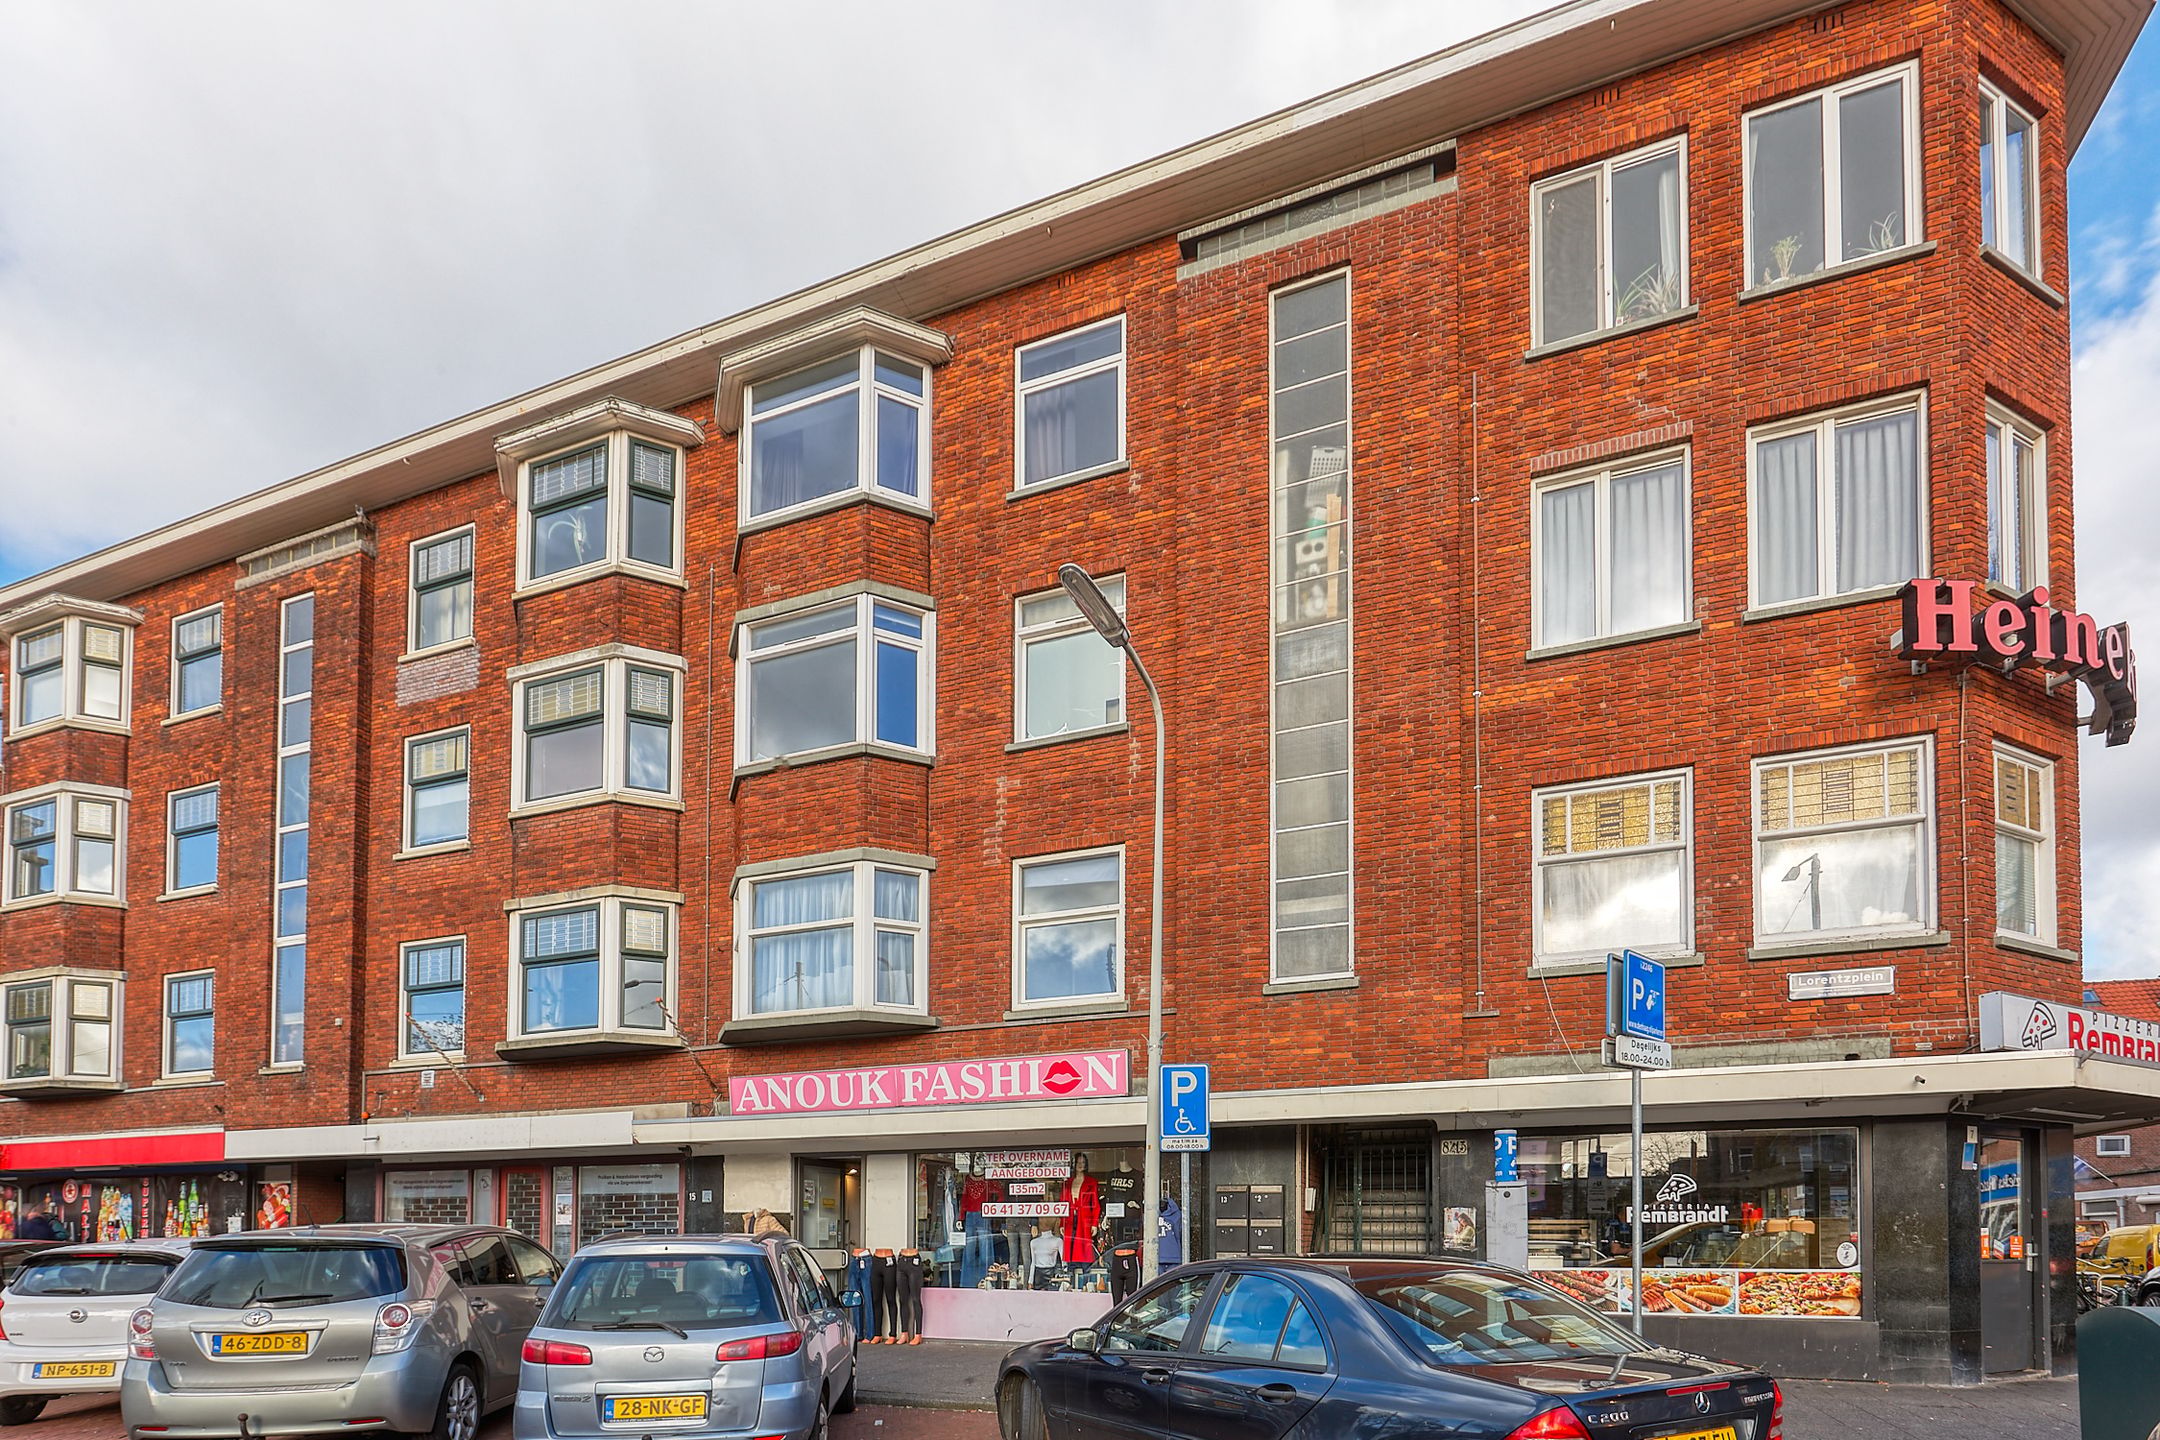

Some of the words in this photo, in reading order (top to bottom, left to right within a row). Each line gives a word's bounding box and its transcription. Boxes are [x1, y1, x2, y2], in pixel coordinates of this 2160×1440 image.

[1798, 971, 1884, 986] Lorentzplein
[1633, 977, 1645, 1011] P
[2067, 1011, 2160, 1063] RemBra
[1631, 1039, 1662, 1054] Dagelijks
[1621, 1052, 1664, 1067] 18.00-24.00
[1665, 1058, 1671, 1067] h
[735, 1071, 892, 1112] ANOUK
[1171, 1071, 1198, 1107] P
[986, 1153, 1005, 1162] TER
[1008, 1151, 1069, 1162] OVERNAME
[991, 1167, 1067, 1178] AANGEBODEN
[1010, 1184, 1045, 1194] 135m2
[688, 1192, 697, 1201] 15
[1220, 1196, 1228, 1204] 13
[983, 1204, 997, 1215] 06
[1000, 1204, 1013, 1215] 41
[1017, 1204, 1032, 1215] 37
[1035, 1204, 1050, 1215] 09
[1053, 1203, 1068, 1215] 67
[225, 1336, 302, 1350] 46-ZDD-8
[46, 1364, 108, 1376] NP-651-B
[620, 1398, 702, 1416] 28-NK-GF
[1588, 1414, 1598, 1424] C
[1600, 1411, 1629, 1424] 200
